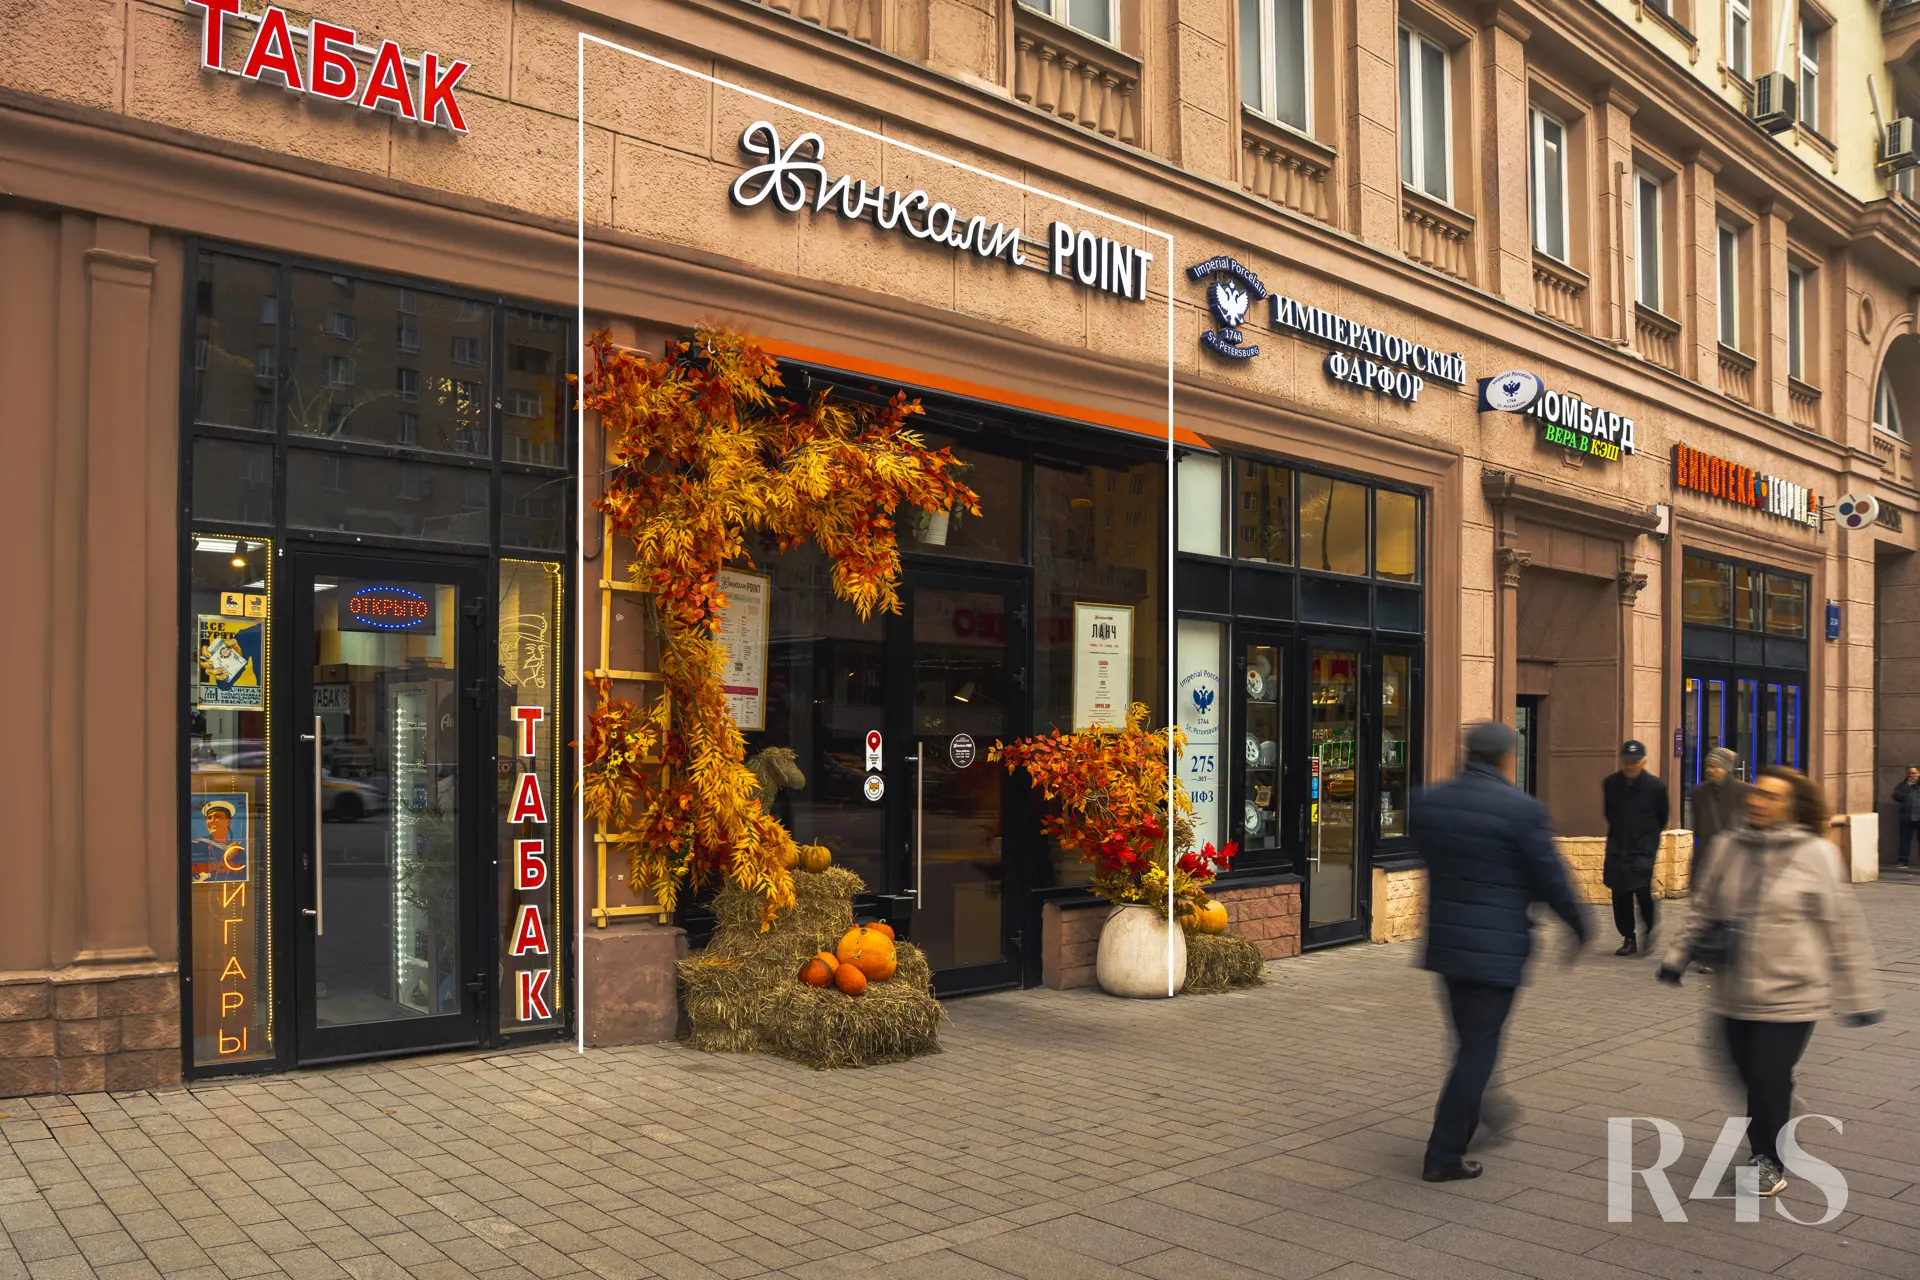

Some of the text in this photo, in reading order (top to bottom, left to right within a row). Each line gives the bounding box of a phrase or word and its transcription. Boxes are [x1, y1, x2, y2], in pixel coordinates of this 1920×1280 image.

[185, 0, 471, 133] ТАБАК
[1051, 221, 1153, 302] POINT
[1194, 257, 1267, 297] Imperial Porcelain
[1225, 329, 1242, 341] 1744
[1273, 294, 1467, 386] ИМПЕРАТОРСКИЙ
[1327, 351, 1425, 403] ФАРФОР
[1545, 423, 1620, 462] ВЕРА В КЭШ
[1677, 442, 1756, 508] ВИНОТЕКА
[200, 621, 226, 632] ВСЕ
[349, 597, 428, 618] ОТКРЫТО
[1091, 624, 1117, 639] ЛАНЧ
[313, 687, 340, 707] ТАБАК
[1179, 669, 1203, 688] Imperial
[1190, 755, 1214, 773] 275
[1191, 790, 1214, 803] ИФЗ
[509, 705, 552, 1021] ТАБАК
[218, 844, 247, 1055] СИГАРЫ
